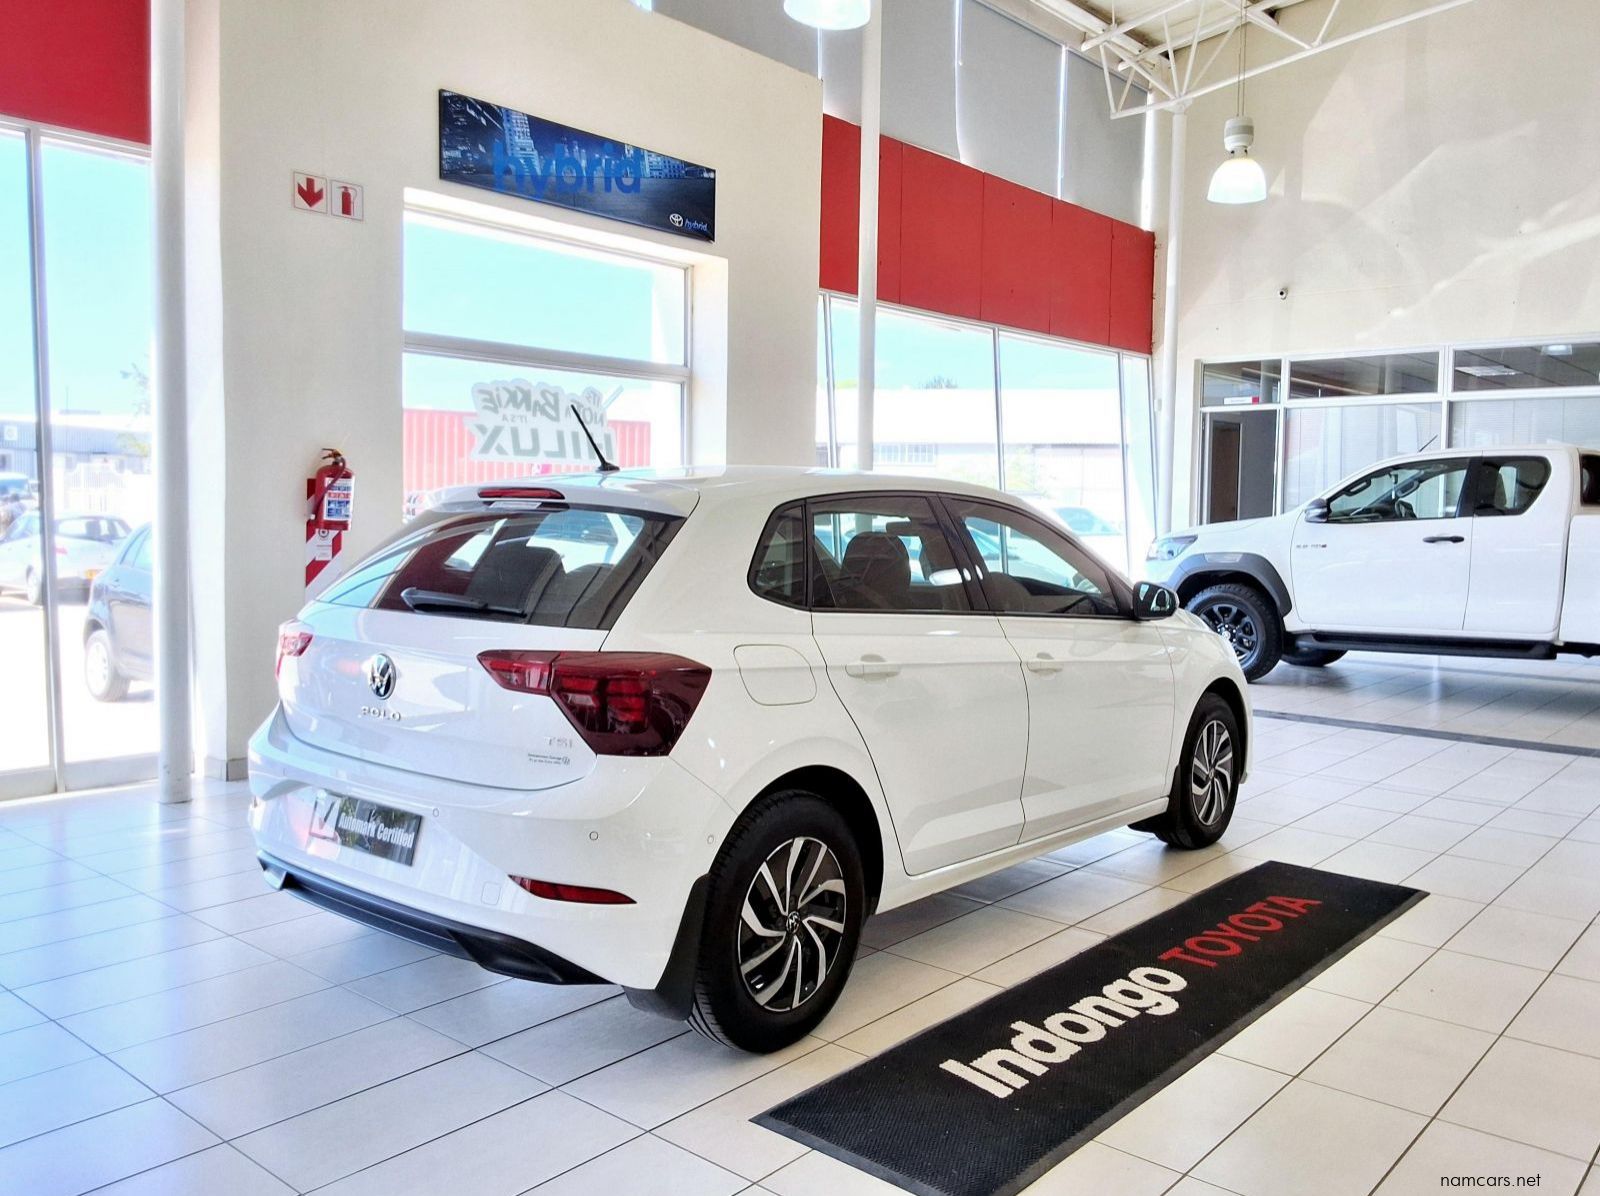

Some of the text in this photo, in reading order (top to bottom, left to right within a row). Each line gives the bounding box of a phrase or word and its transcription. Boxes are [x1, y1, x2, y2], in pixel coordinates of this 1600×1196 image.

[492, 141, 641, 197] hybrid
[685, 218, 708, 231] hybrid
[338, 812, 415, 849] Automark Certified
[939, 895, 1322, 1099] Indongo TOYOTA
